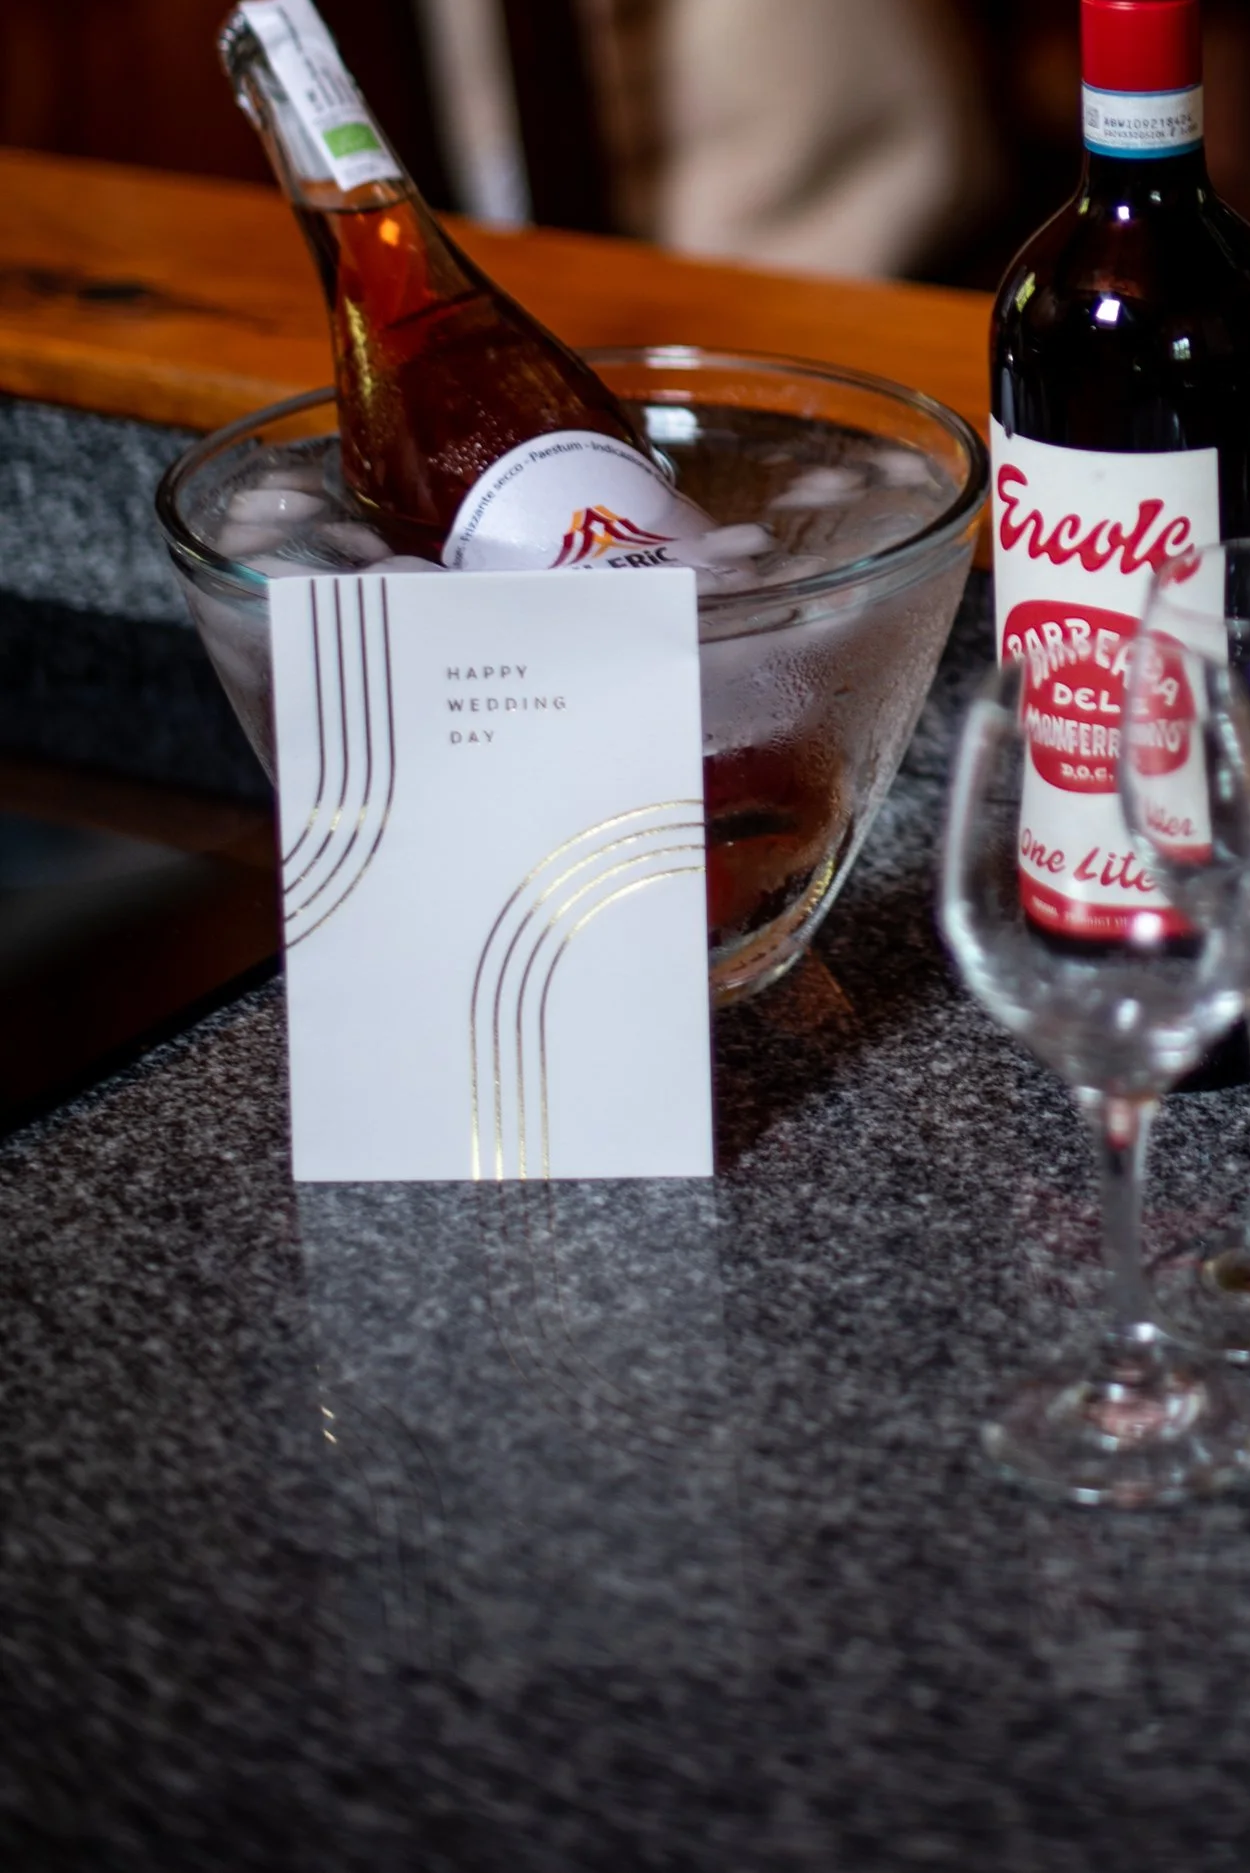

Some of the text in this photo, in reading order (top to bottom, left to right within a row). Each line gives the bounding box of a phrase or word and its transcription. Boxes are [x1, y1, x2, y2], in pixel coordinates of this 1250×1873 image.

[528, 440, 584, 462] Paestum
[997, 463, 1201, 584] Ercole
[447, 665, 527, 680] HAPPY
[447, 696, 566, 712] WEDDING
[1053, 681, 1120, 713] DEL
[450, 730, 494, 744] DAY
[1020, 828, 1161, 892] One Lite
